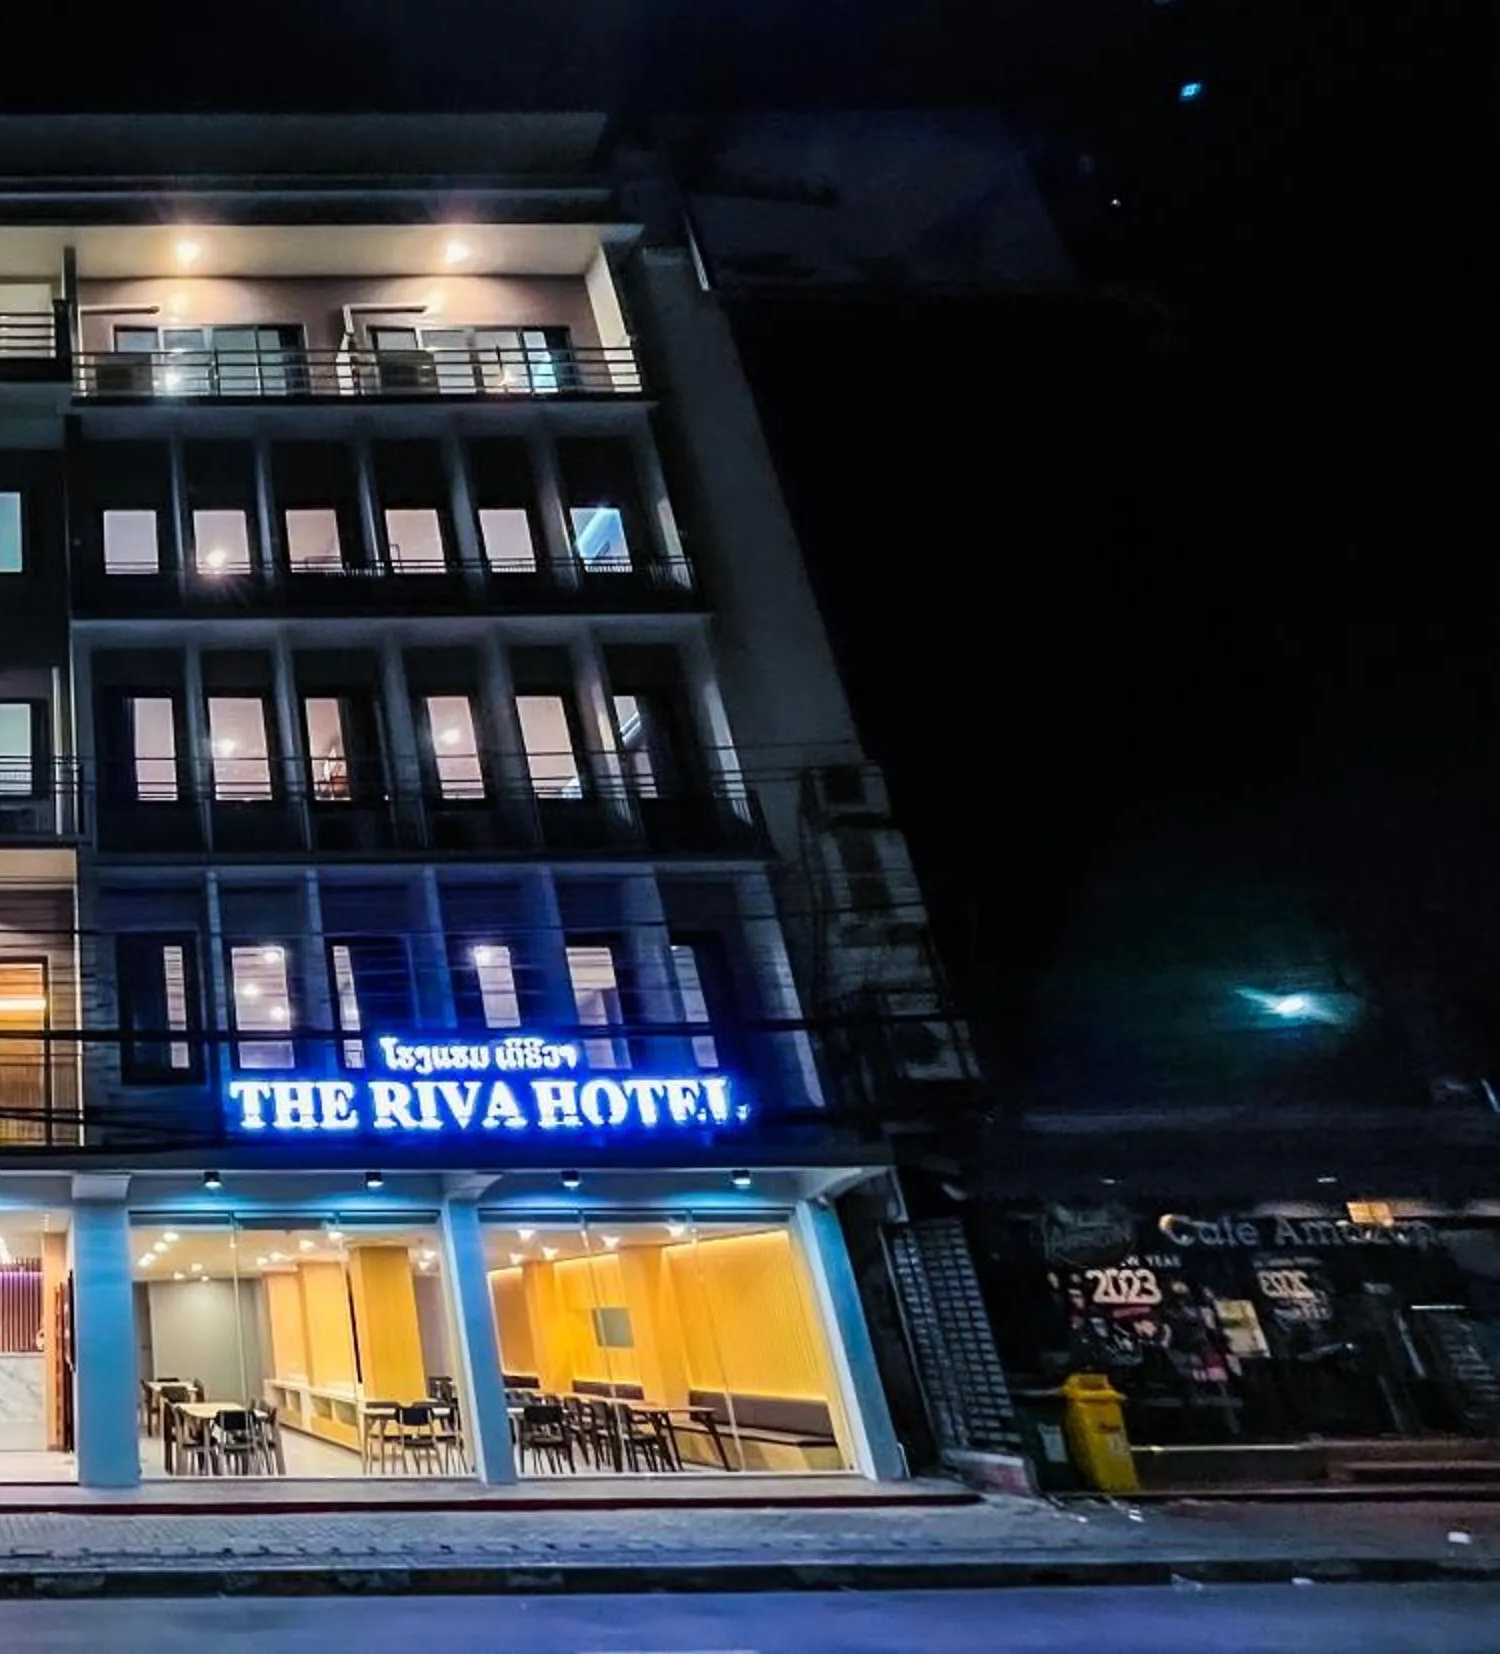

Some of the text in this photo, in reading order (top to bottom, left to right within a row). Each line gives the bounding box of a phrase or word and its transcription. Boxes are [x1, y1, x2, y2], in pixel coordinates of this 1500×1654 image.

[230, 1081, 358, 1129] THE
[372, 1081, 528, 1128] RIVA
[1159, 1214, 1258, 1247] Cafe
[1086, 1269, 1162, 1304] 2023
